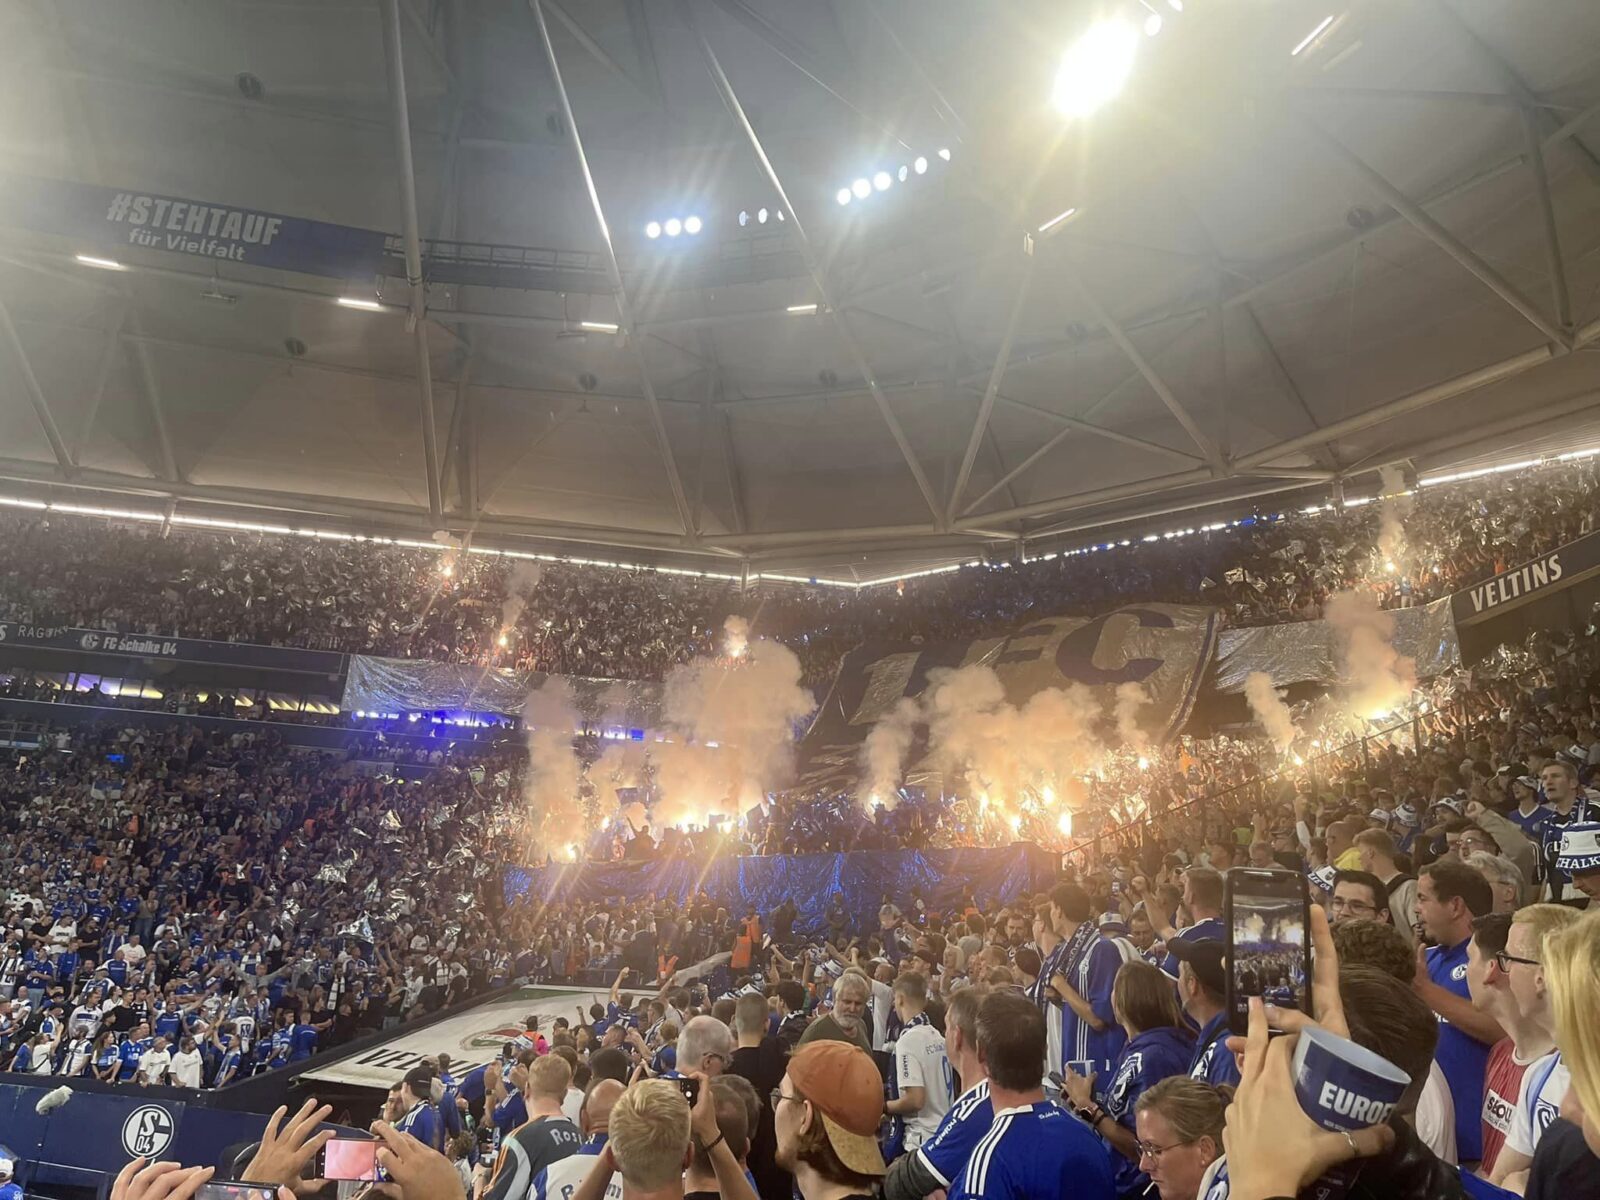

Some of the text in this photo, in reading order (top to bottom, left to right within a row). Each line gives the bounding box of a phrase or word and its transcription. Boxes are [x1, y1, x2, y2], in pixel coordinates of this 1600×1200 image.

[106, 192, 282, 246] #STEHTAUF
[128, 228, 245, 261] für Vielfalt
[1470, 553, 1562, 612] VELTINS
[103, 636, 177, 655] FC Schalke 04
